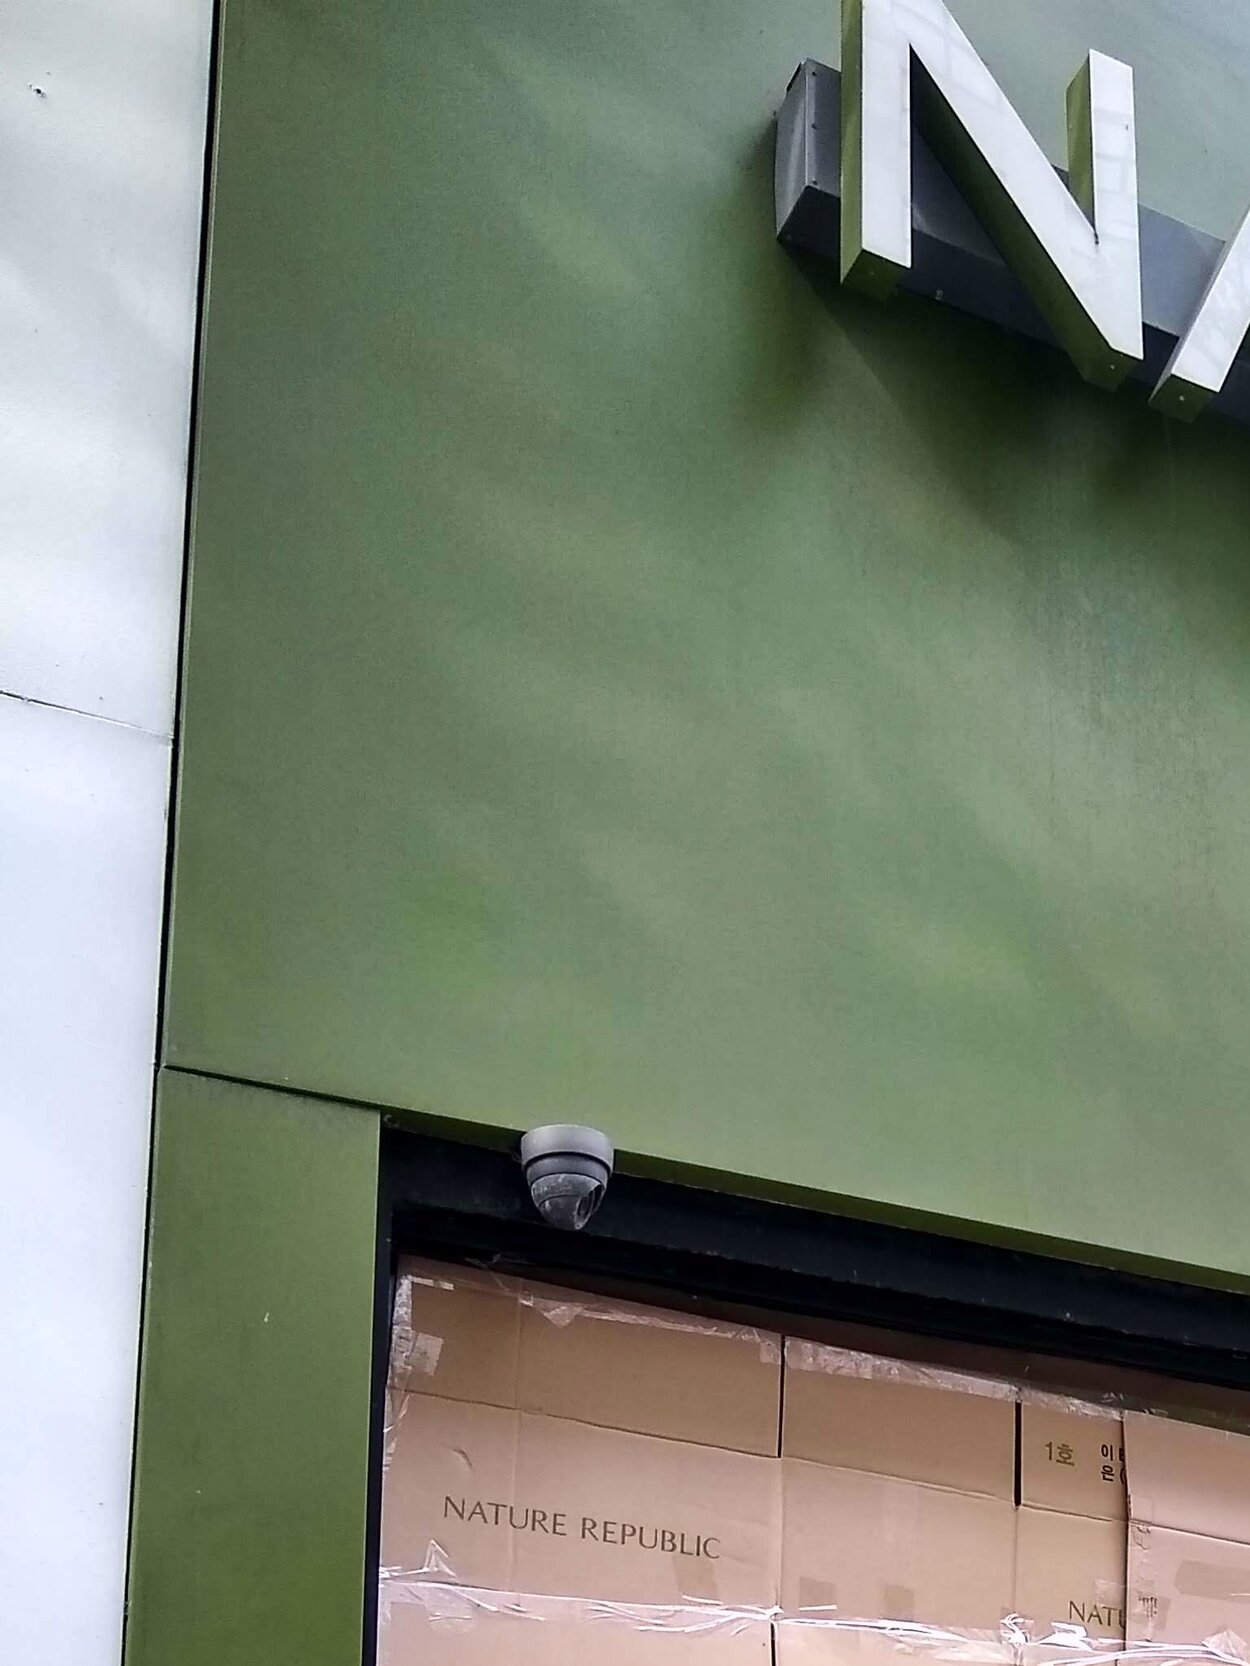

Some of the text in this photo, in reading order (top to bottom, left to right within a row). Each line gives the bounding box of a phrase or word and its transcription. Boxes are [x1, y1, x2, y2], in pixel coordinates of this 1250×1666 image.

[1045, 1441, 1075, 1467] 1호
[442, 1495, 722, 1561] NATURE REPUBLIC
